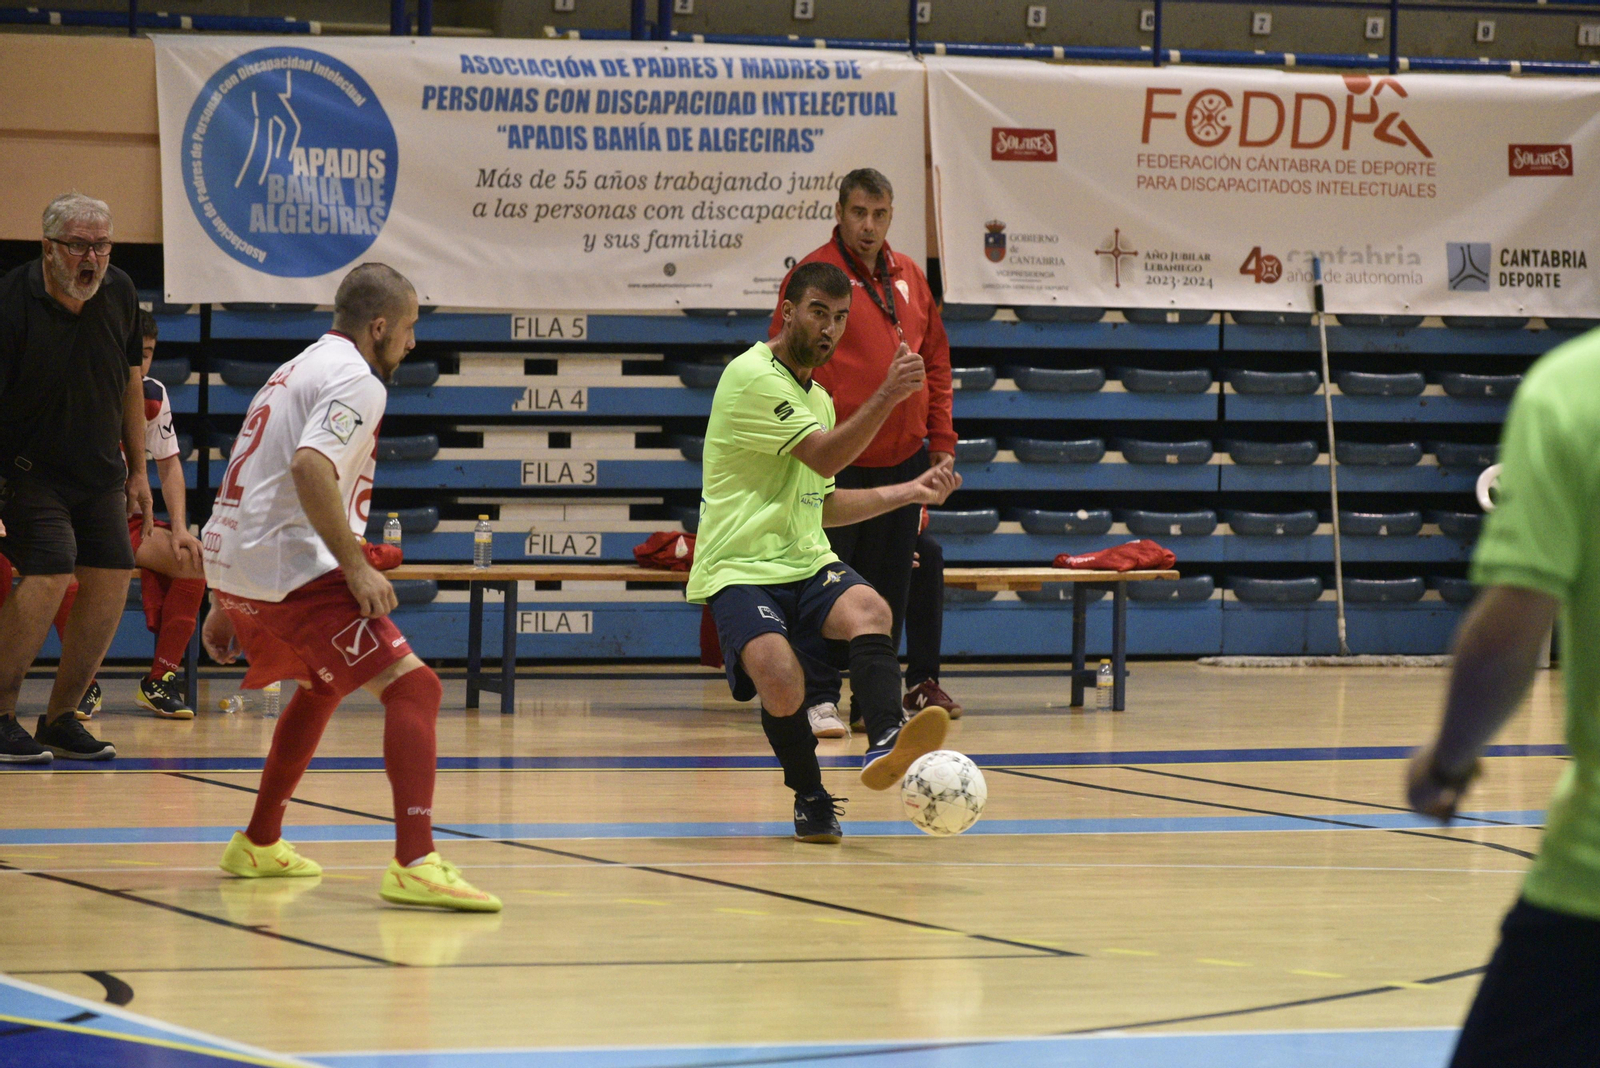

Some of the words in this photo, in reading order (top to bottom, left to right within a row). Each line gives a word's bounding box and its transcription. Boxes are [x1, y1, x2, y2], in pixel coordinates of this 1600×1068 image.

[800, 2, 808, 14] 3
[1033, 9, 1042, 23] 5
[1258, 17, 1266, 31] 7
[1482, 26, 1491, 39] 9
[236, 56, 314, 81] Discapacidad
[460, 54, 597, 78] ASOCIACIÓN
[600, 58, 630, 78] DE
[632, 57, 718, 79] PADRES
[721, 57, 735, 78] Y
[740, 57, 830, 80] MADRES
[834, 59, 862, 80] DE
[218, 75, 240, 96] con
[313, 61, 366, 107] Intelectual
[421, 85, 539, 113] PERSONAS
[544, 88, 591, 114] CON
[595, 90, 757, 115] DISCAPACIDAD
[762, 91, 898, 117] INTELECTUAL
[192, 90, 223, 142] Personas
[593, 122, 662, 151] BAHÍA
[666, 127, 693, 151] DE
[190, 142, 203, 159] de
[292, 147, 386, 179] APADIS
[1136, 153, 1241, 171] FEDERACIÓN
[1245, 155, 1331, 174] CÁNTABRA
[1335, 160, 1356, 174] DE
[1361, 161, 1437, 176] DEPORTE
[193, 160, 210, 203] Padres
[354, 178, 386, 207] DE
[475, 168, 522, 189] Más
[529, 168, 556, 189] de
[563, 170, 587, 190] 55
[594, 171, 648, 190] años
[654, 171, 783, 195] trabajando
[1136, 175, 1177, 190] PARA
[1180, 176, 1312, 195] DISCAPACITADOS
[1316, 180, 1437, 198] INTELECTUALES
[203, 202, 217, 218] de
[249, 203, 386, 236] ALGECIRAS
[472, 202, 487, 218] a
[493, 199, 528, 218] las
[533, 204, 637, 223] personas
[643, 205, 686, 221] con
[691, 200, 834, 223] discapacida
[582, 232, 596, 252] y
[603, 233, 640, 249] sus
[645, 229, 744, 252] familias
[1009, 233, 1059, 243] GOBIERNO
[1009, 256, 1066, 266] CANTABRIA
[1144, 262, 1203, 273] LEBANIEGO
[1500, 248, 1588, 269] CANTABRIA
[1287, 268, 1314, 283] año
[1323, 268, 1342, 283] de
[1345, 269, 1423, 285] autonomía
[1499, 272, 1562, 288] DEPORTE
[513, 316, 564, 338] FILA
[571, 317, 584, 338] 5
[570, 389, 584, 410] 4
[522, 462, 574, 484] FILA
[582, 462, 595, 484] 3
[528, 533, 577, 555] FILA
[584, 535, 597, 555] 2
[520, 612, 571, 633] FILA
[581, 612, 590, 633] 1
